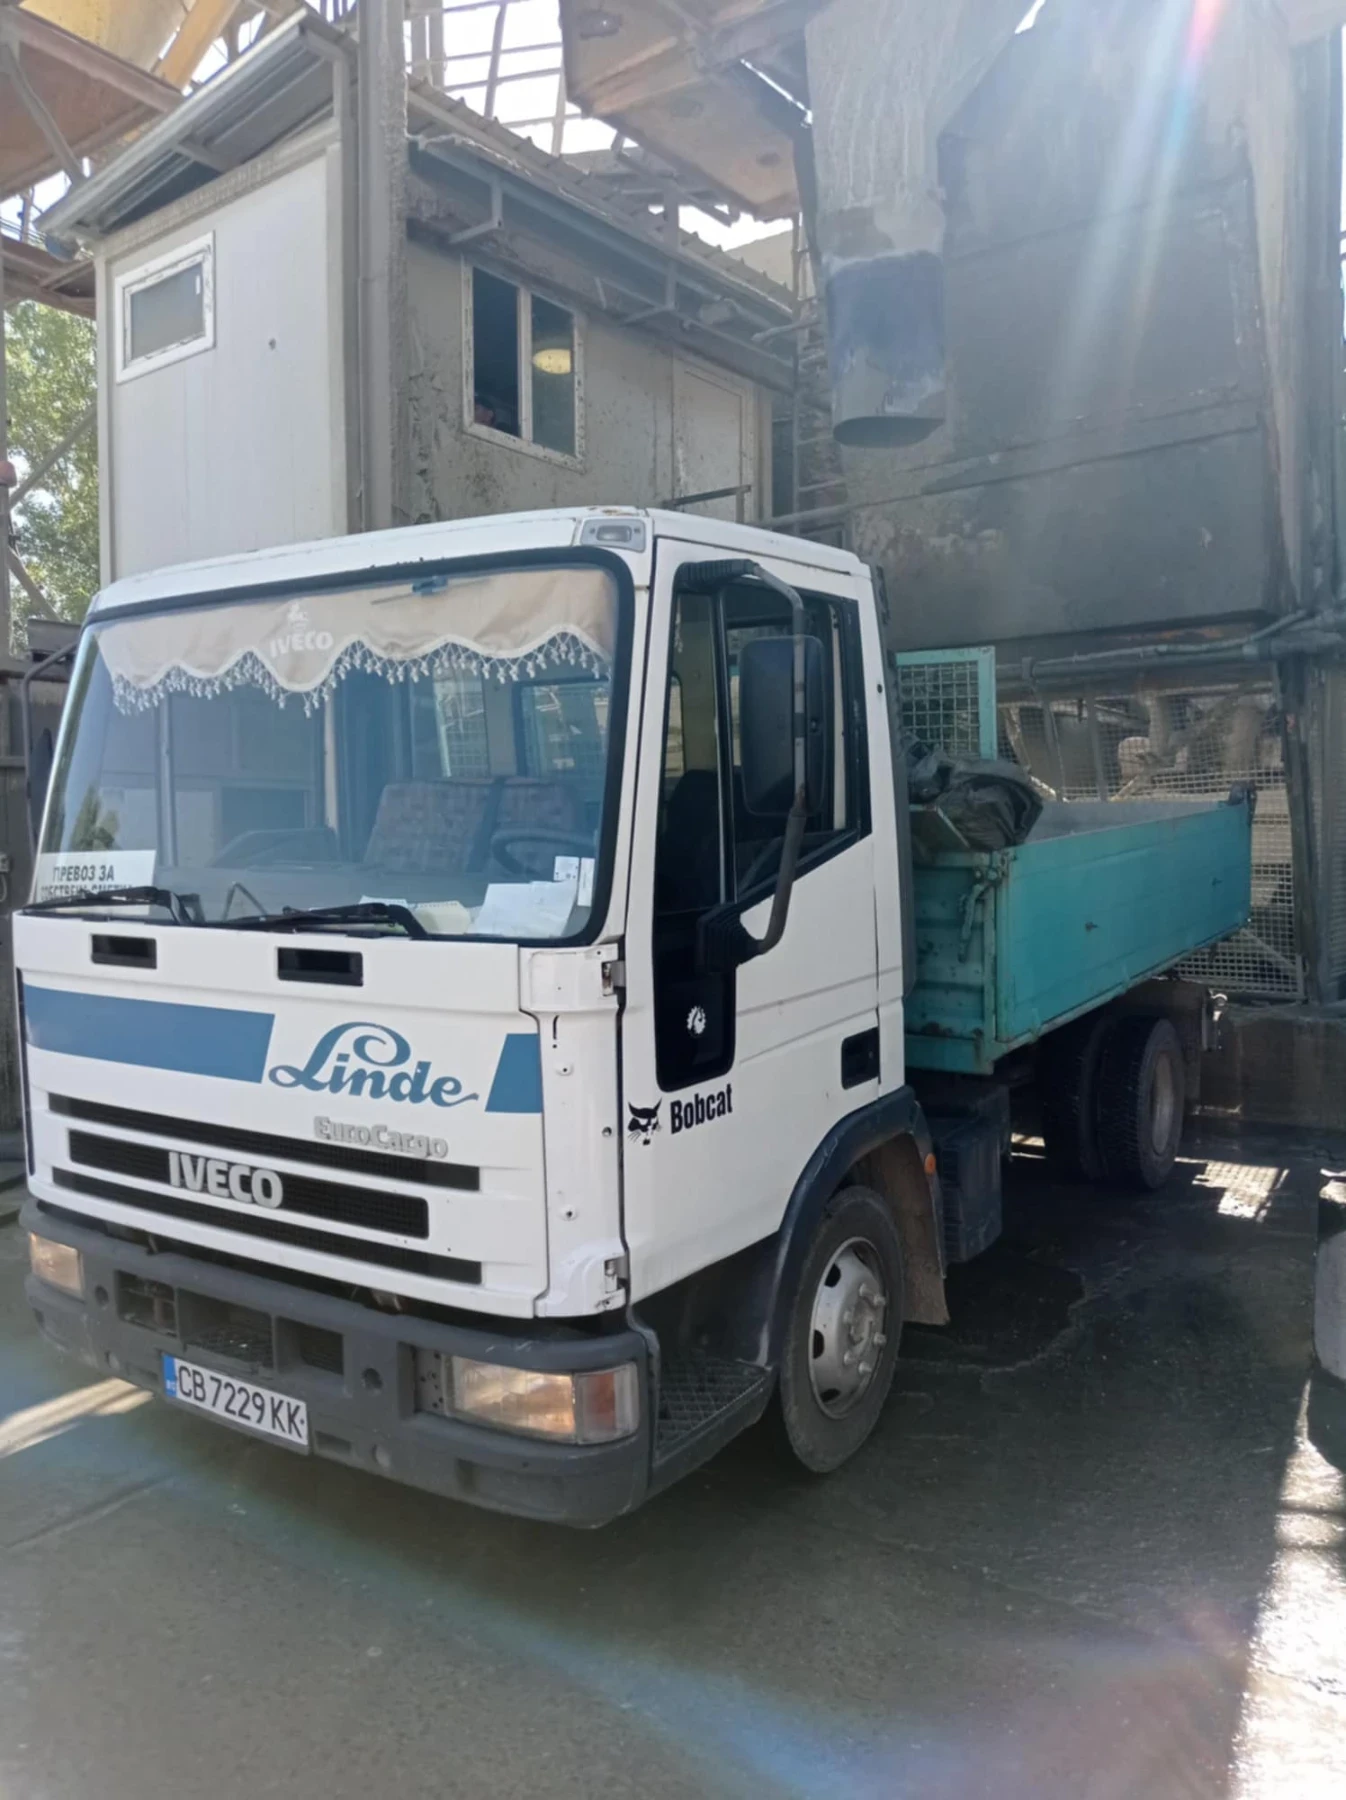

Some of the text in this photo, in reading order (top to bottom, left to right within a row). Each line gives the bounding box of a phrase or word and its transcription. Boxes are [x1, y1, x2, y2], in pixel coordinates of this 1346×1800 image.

[269, 630, 334, 658] IVECO
[52, 864, 115, 882] ПРЕВОЗ ЗА
[268, 1021, 480, 1107] Linde
[670, 1083, 733, 1135] Bobcat
[313, 1115, 449, 1159] EuroCargo
[168, 1151, 283, 1209] IVECO
